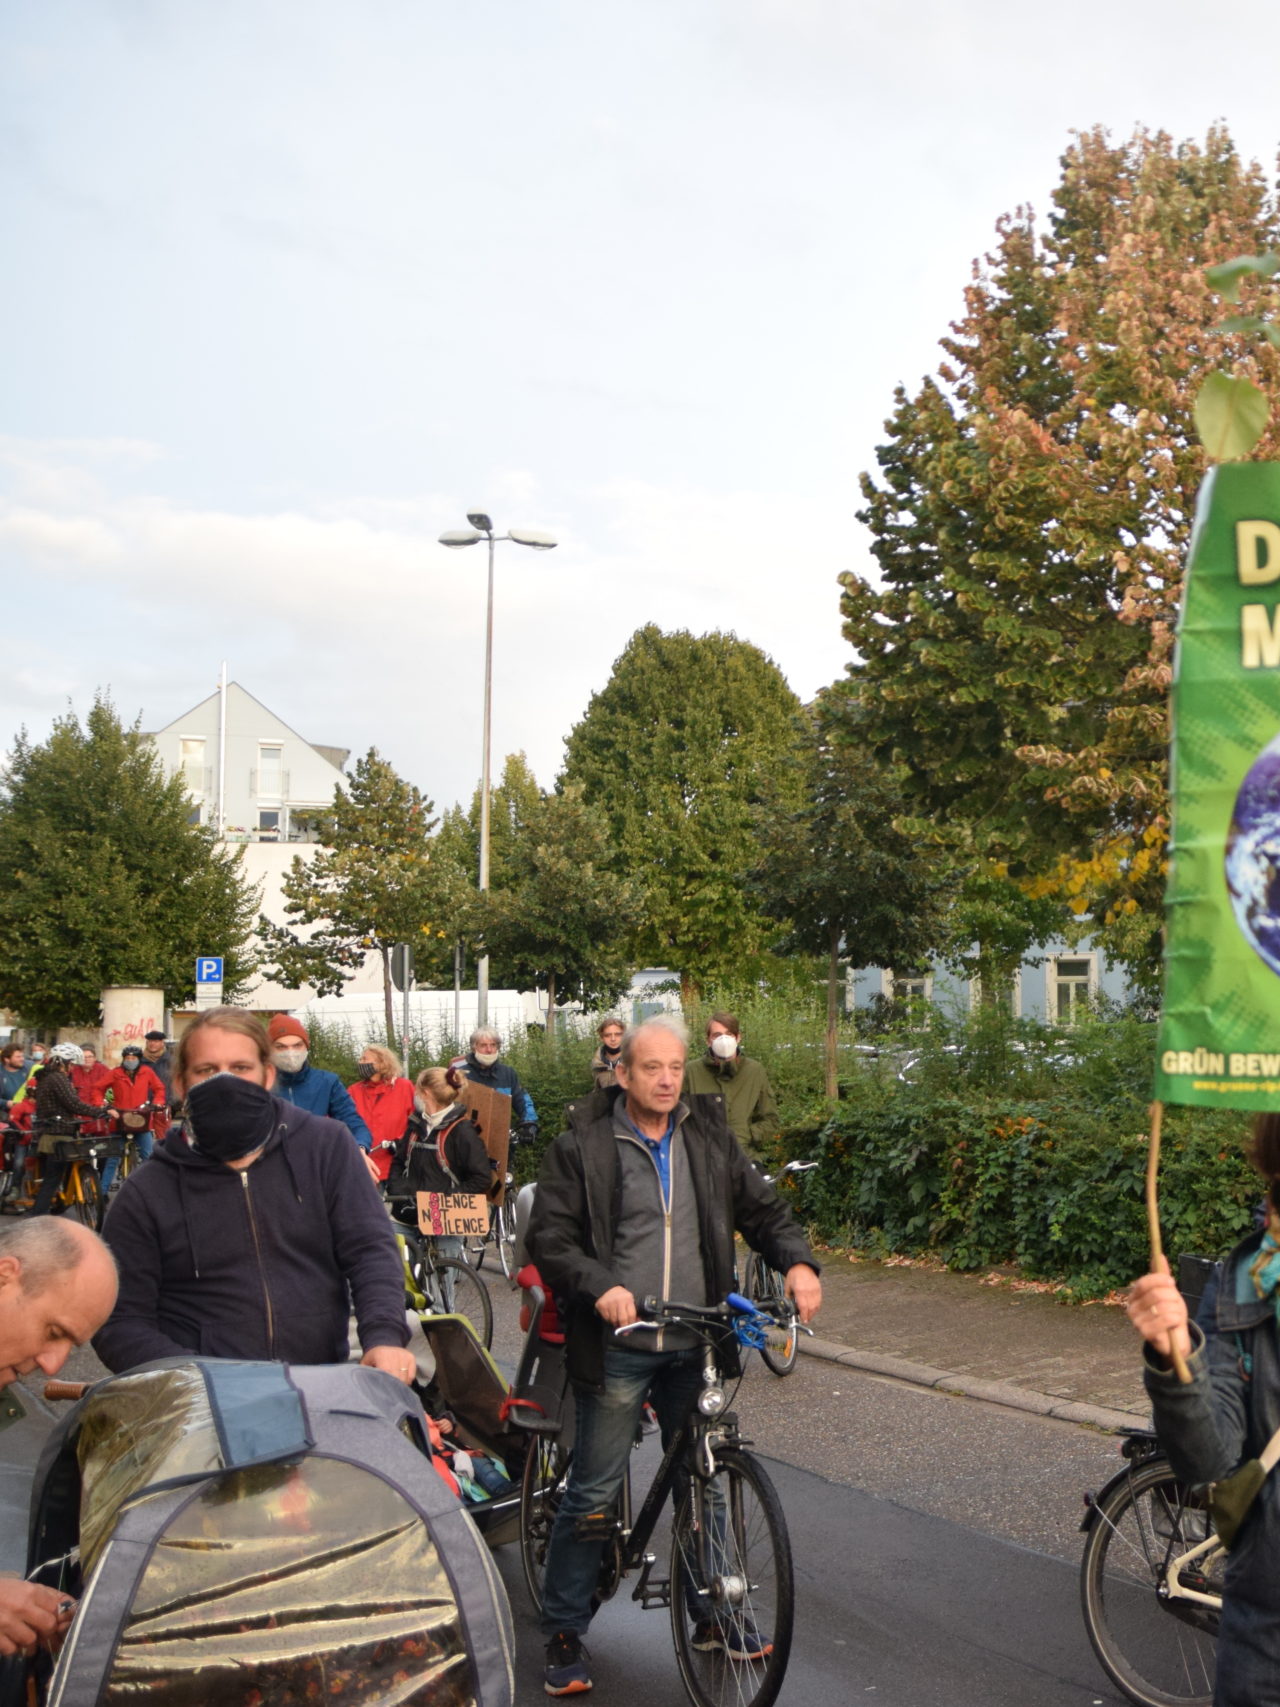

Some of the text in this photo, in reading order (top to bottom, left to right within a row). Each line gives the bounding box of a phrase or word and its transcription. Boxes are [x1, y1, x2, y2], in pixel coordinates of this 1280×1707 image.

[202, 960, 217, 980] P
[1161, 1047, 1225, 1076] GRÜN
[421, 1208, 449, 1223] NOT
[432, 1218, 487, 1236] SILENCE
